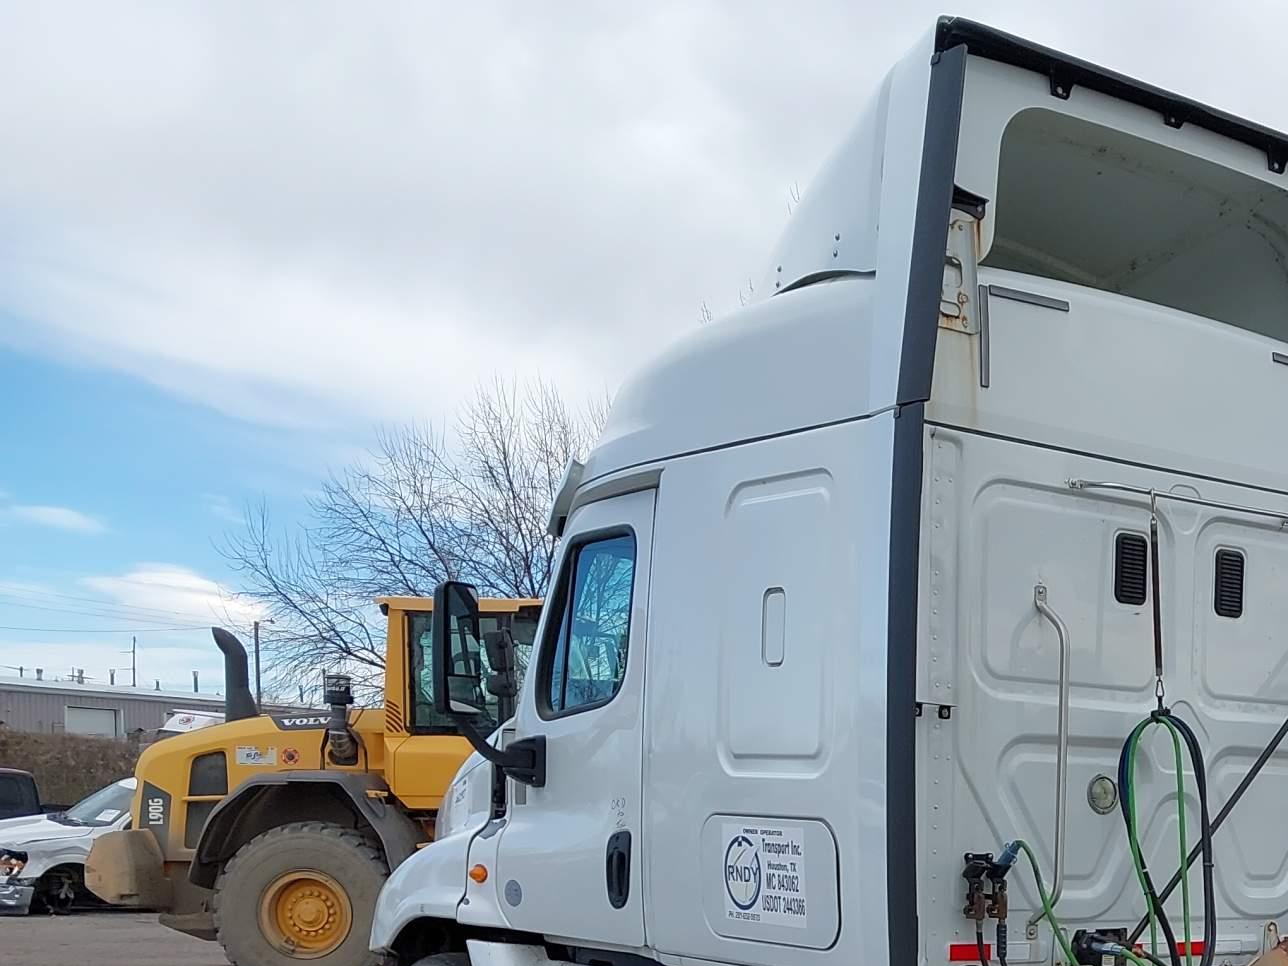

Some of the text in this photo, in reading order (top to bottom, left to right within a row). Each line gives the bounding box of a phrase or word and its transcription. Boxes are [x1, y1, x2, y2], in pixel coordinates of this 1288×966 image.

[280, 716, 332, 726] VOLV
[148, 797, 163, 825] L90G
[762, 838, 802, 858] Transport Inc.
[728, 864, 760, 883] RNDY
[767, 860, 797, 872] Houston, TX
[766, 874, 800, 892] MC 843062
[762, 895, 782, 912] USDOT
